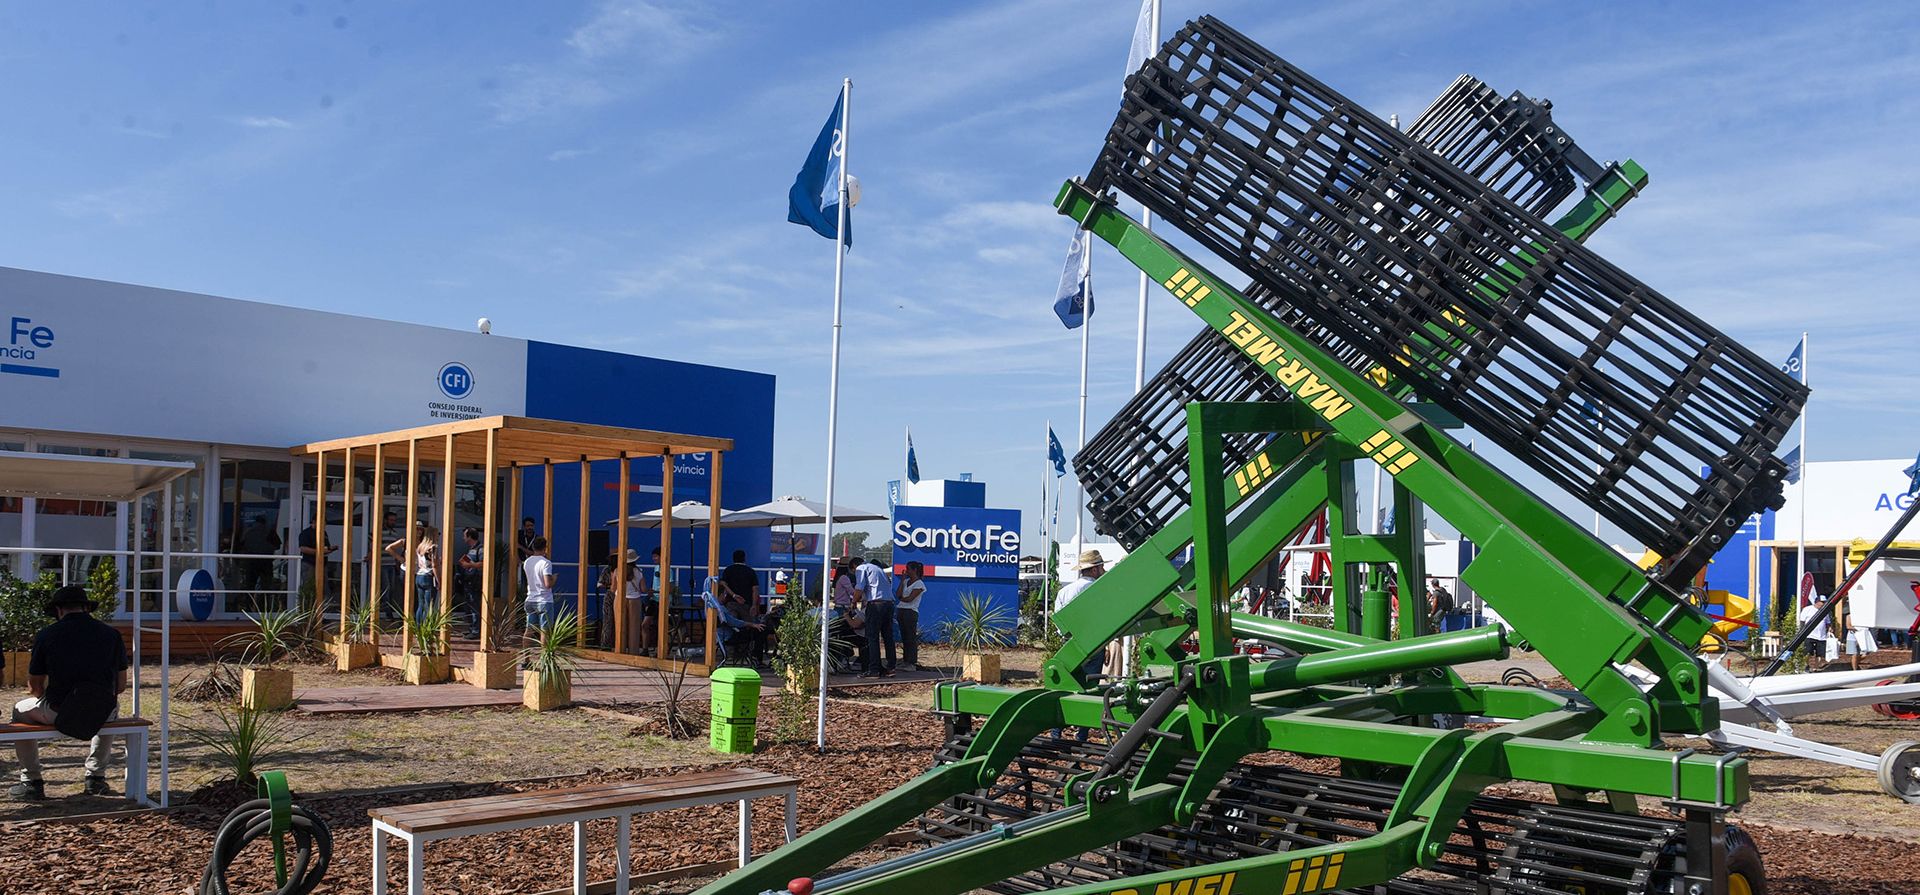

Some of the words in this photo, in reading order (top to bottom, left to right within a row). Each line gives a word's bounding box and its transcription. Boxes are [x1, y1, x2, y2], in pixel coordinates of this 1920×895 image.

[10, 316, 54, 349] Fe
[0, 346, 35, 360] ncia
[1222, 310, 1355, 422] MAR-MEL
[445, 373, 466, 389] CFI
[428, 402, 456, 411] CONSEJO
[456, 405, 483, 414] FEDERAL
[430, 410, 439, 418] DE
[893, 520, 981, 549] Santa
[985, 525, 1020, 551] Fe
[956, 550, 1018, 563] Provincia
